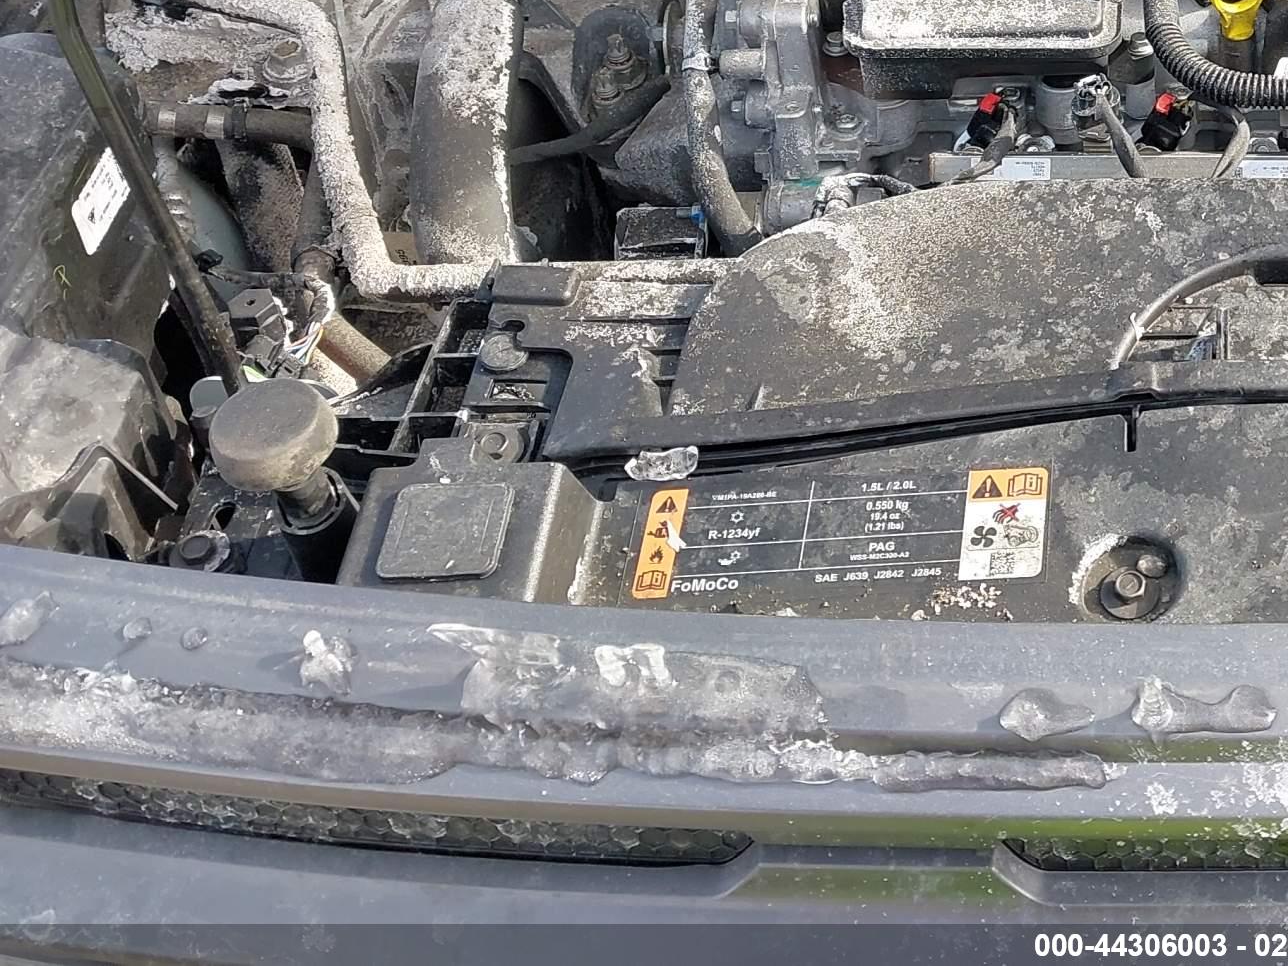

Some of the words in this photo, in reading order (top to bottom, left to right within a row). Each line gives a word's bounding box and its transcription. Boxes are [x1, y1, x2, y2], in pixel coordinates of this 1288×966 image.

[861, 483, 885, 492] 1.5L
[893, 480, 917, 490] 2.0L
[866, 501, 894, 511] 0.550
[895, 500, 909, 511] kg
[870, 512, 888, 521] 19.4
[864, 523, 886, 533] (1.21
[887, 521, 905, 531] lbs)
[708, 527, 761, 540] R-1234yf
[868, 541, 896, 552] PAG
[814, 573, 839, 583] SAE
[874, 569, 905, 580] J2842
[911, 567, 942, 577] J2845
[670, 577, 739, 593] FoMoCo
